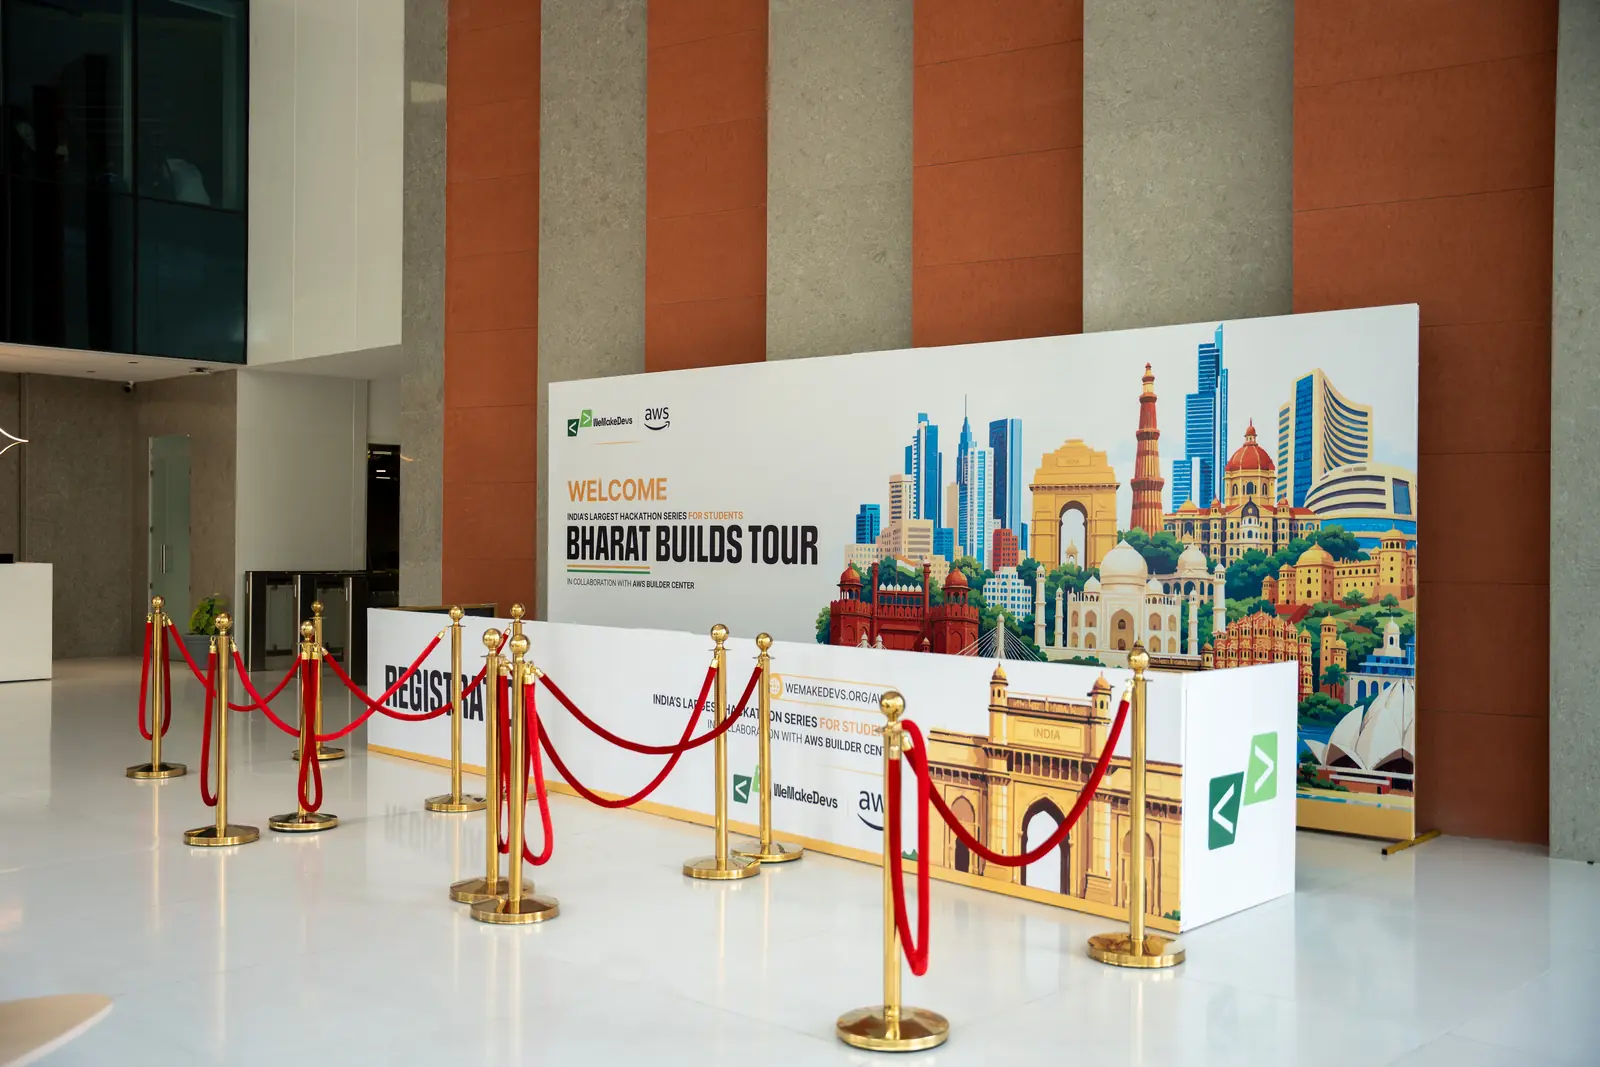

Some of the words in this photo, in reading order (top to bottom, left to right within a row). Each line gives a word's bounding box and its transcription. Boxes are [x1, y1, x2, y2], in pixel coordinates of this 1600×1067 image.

[592, 416, 633, 427] WeMakeDevs
[644, 406, 670, 421] aws
[567, 477, 668, 502] WELCOME
[567, 512, 588, 521] INDIA'S
[589, 512, 619, 521] LARGEST
[619, 512, 662, 521] HACKATHON
[663, 511, 687, 521] SERIES
[688, 511, 703, 520] FOR
[703, 511, 744, 520] STUDENTS
[566, 525, 651, 561] BHARAT
[655, 524, 743, 564] BUILDS
[748, 524, 819, 565] TOUR
[567, 578, 573, 586] IN
[573, 578, 617, 587] COLLABORATION
[617, 579, 632, 588] WITH
[632, 580, 646, 588] AWS
[646, 580, 671, 589] BUILDER
[671, 581, 695, 590] CENTER
[385, 664, 512, 727] REGISTA
[785, 682, 882, 705] WEMAKEDEVS.ORG/A
[652, 693, 682, 708] INDIA'S
[683, 697, 715, 713] LAES
[784, 712, 818, 728] SERIES
[819, 717, 840, 731] FOR
[842, 720, 881, 737] STUDE
[781, 730, 803, 744] WITH
[804, 734, 824, 747] AWS
[825, 737, 862, 754] BUILDER
[864, 743, 884, 757] CEN
[1033, 727, 1061, 741] INDIA
[773, 782, 838, 809] WeMakeDevs
[858, 789, 884, 813] aw
